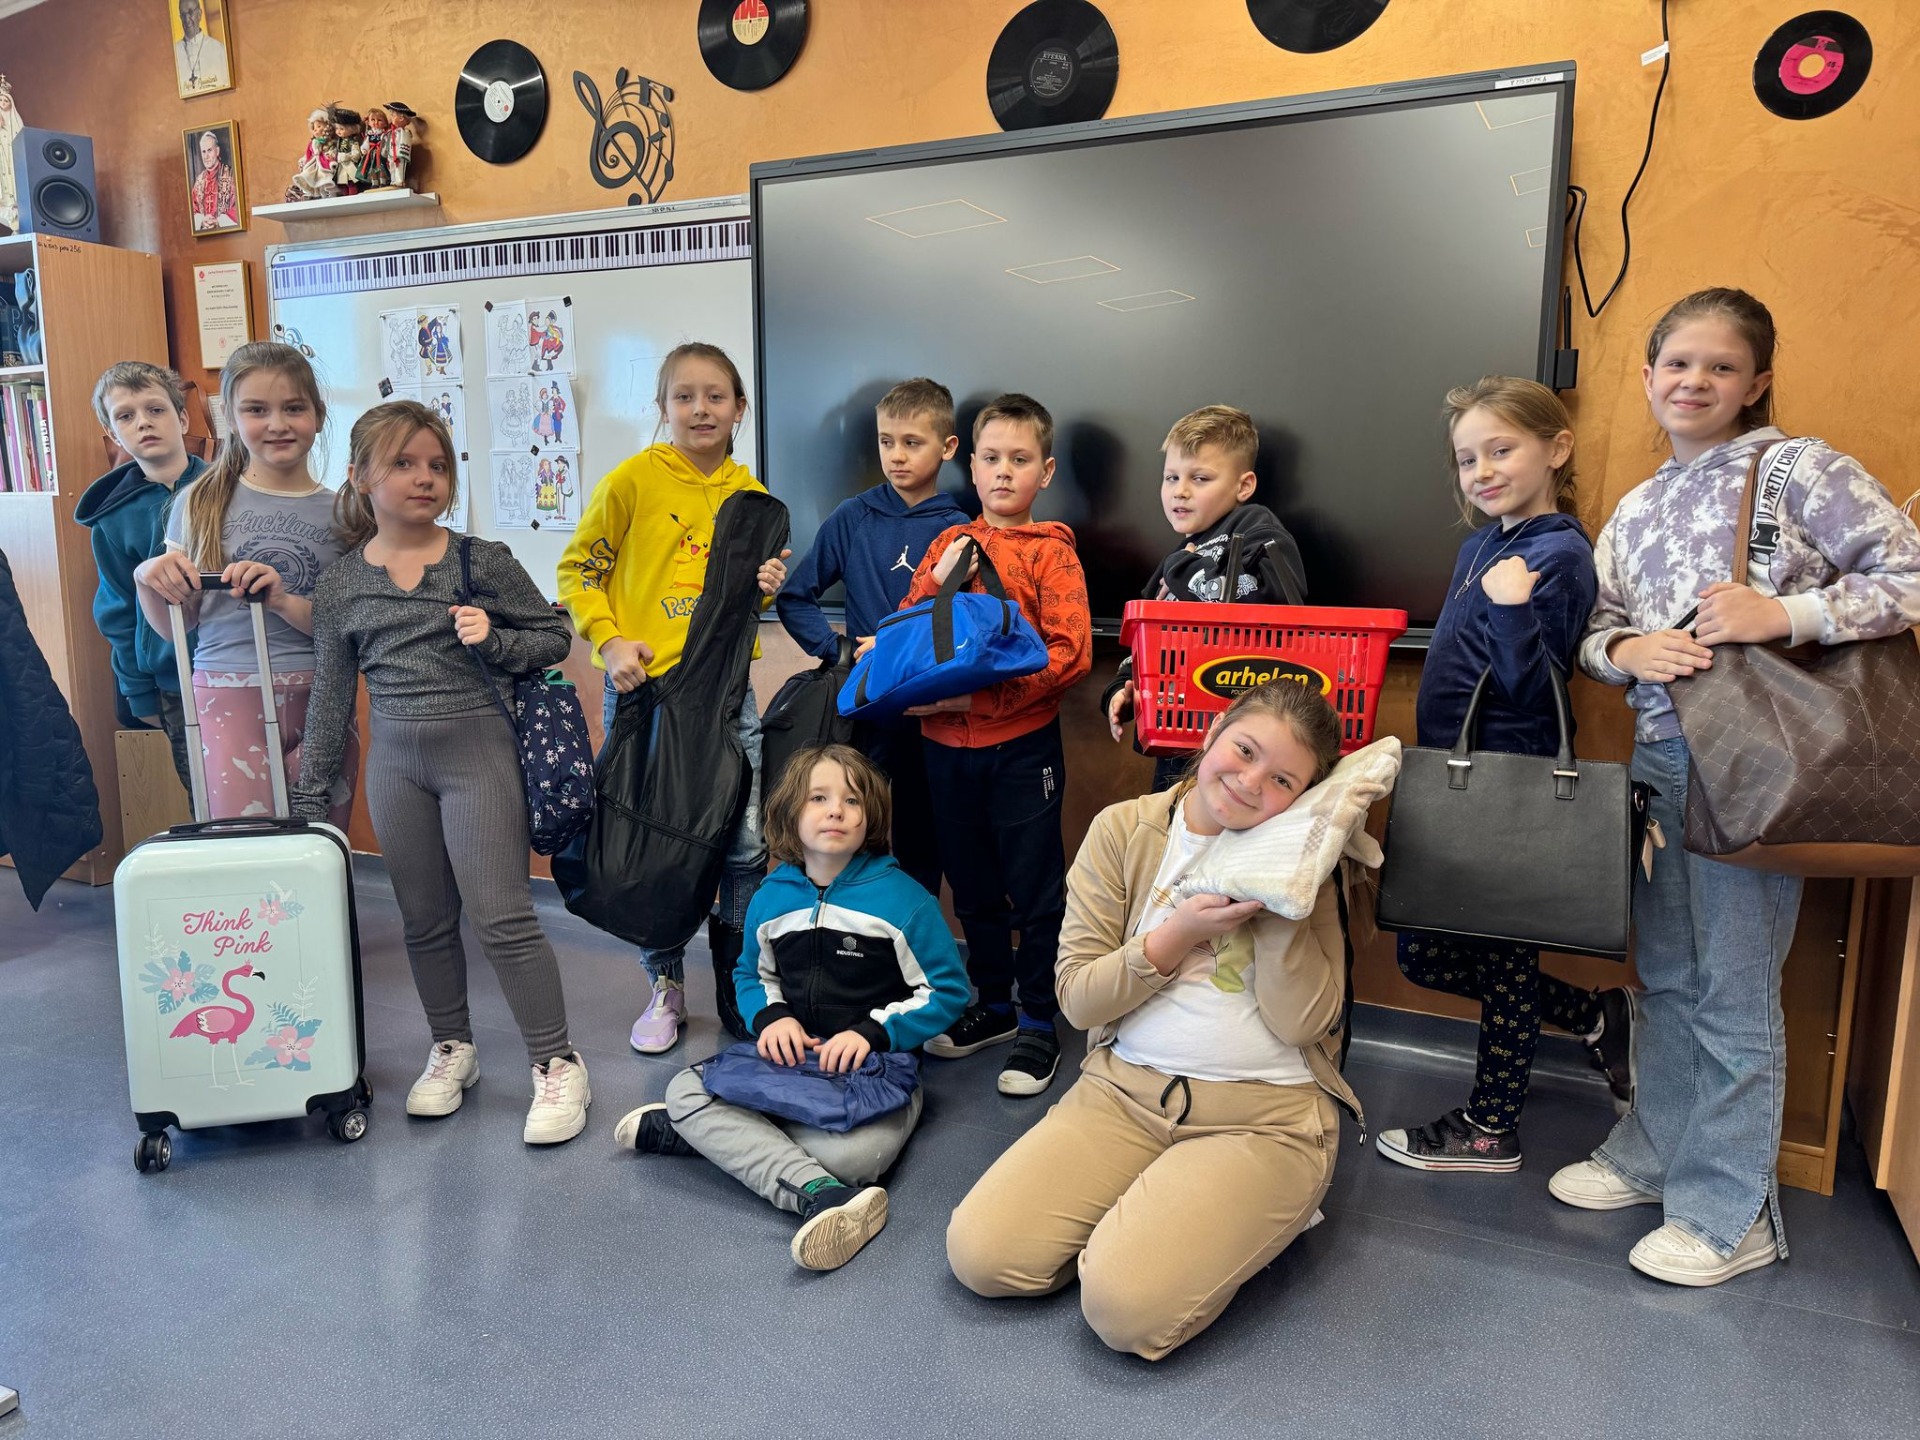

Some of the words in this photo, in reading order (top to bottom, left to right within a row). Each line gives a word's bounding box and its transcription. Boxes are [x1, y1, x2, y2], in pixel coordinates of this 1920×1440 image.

[1777, 444, 1802, 466] COOL
[221, 510, 332, 545] Auckland
[182, 907, 254, 935] Think
[213, 930, 273, 957] Pink
